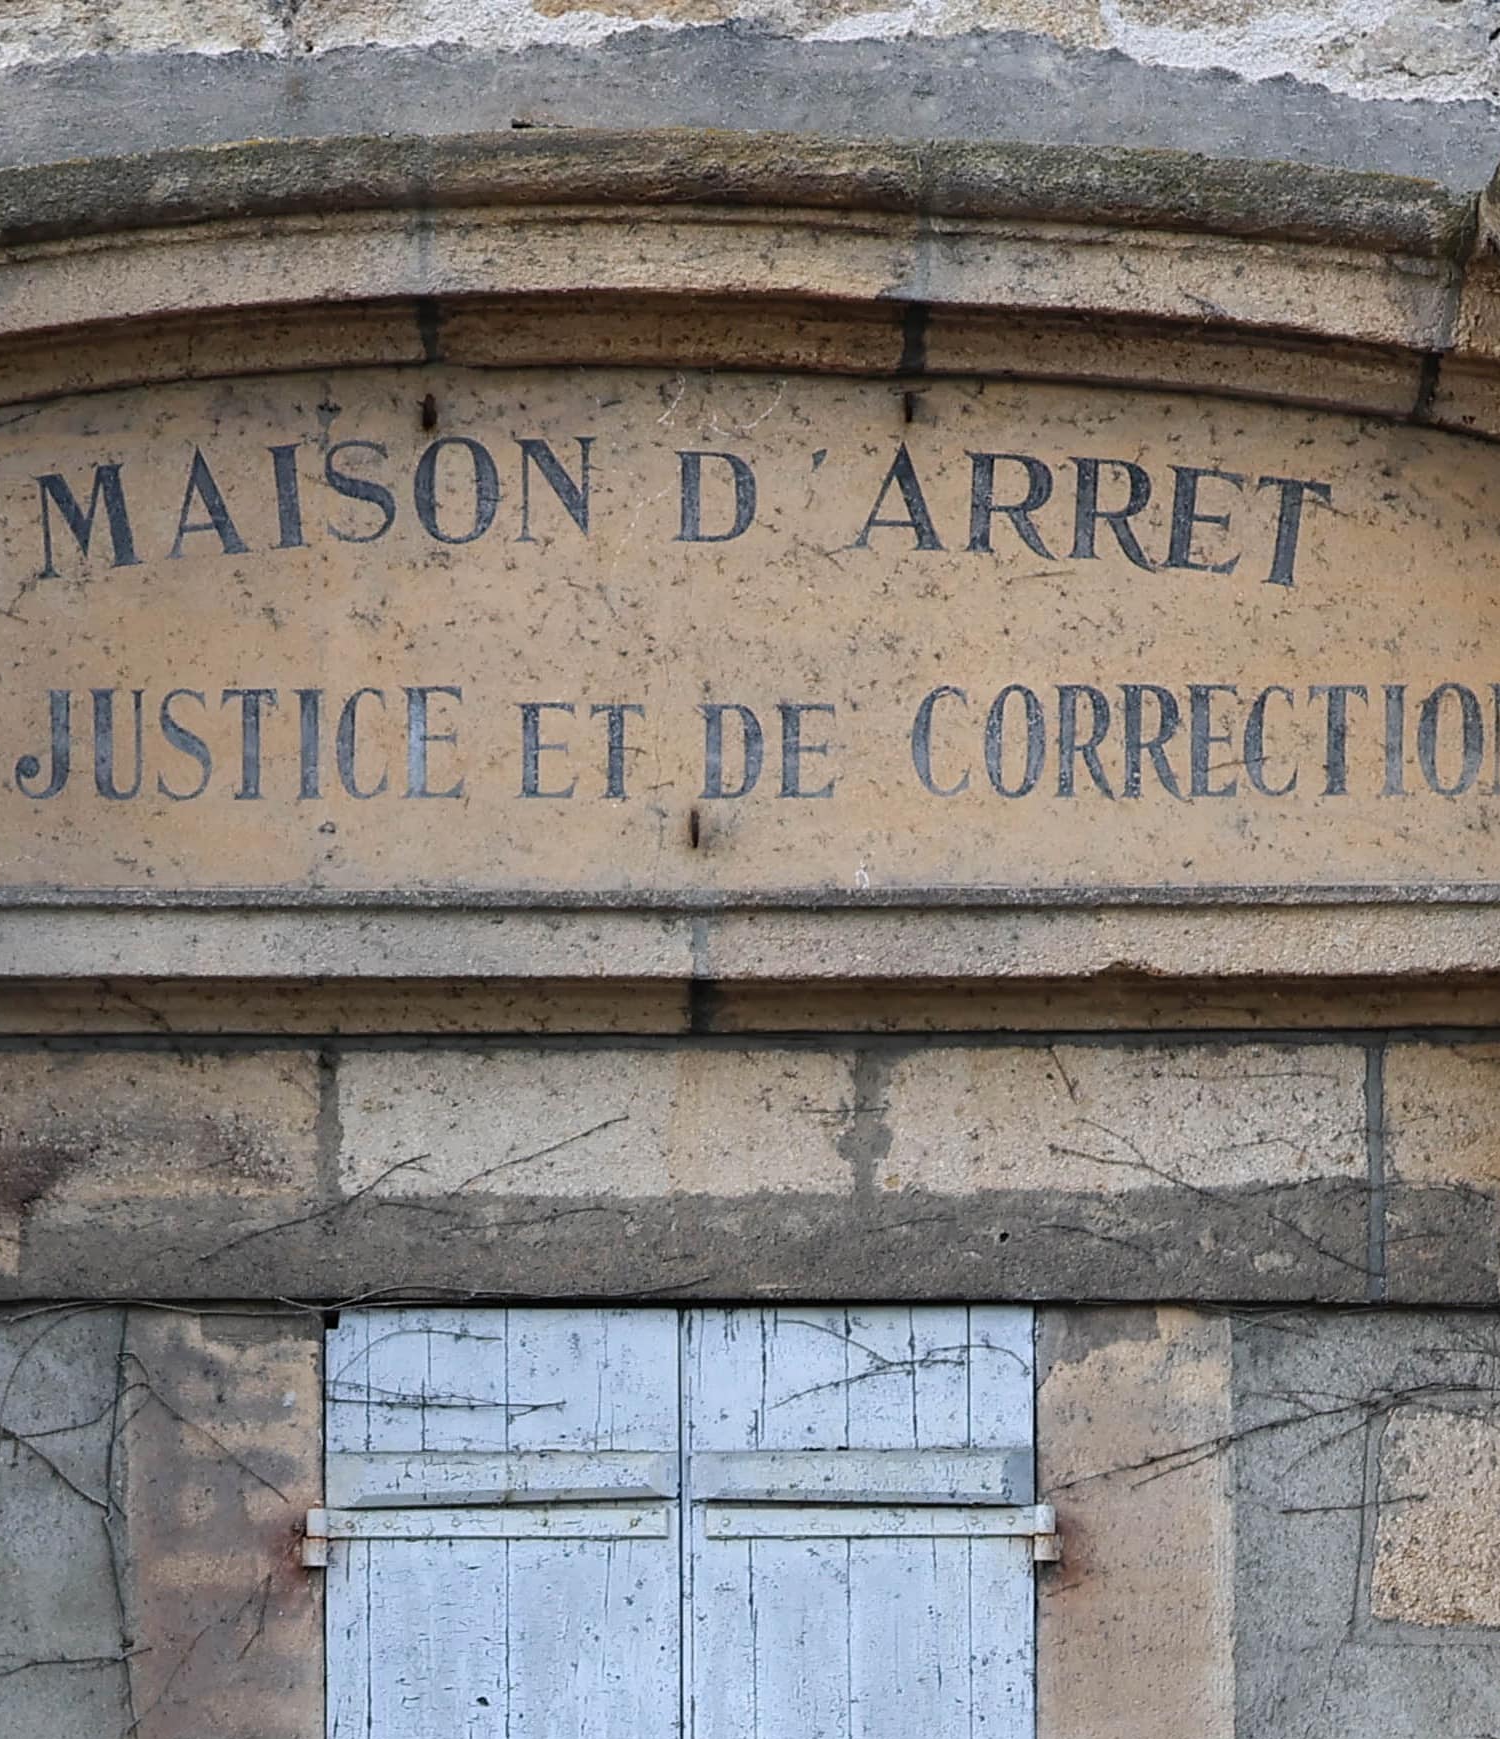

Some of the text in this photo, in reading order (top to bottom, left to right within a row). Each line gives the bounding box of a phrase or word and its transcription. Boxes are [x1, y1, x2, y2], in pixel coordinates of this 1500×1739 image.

[34, 436, 596, 578] MAISON
[14, 685, 465, 801] JUSTICE
[515, 702, 646, 800] ET
[697, 703, 836, 799] DE
